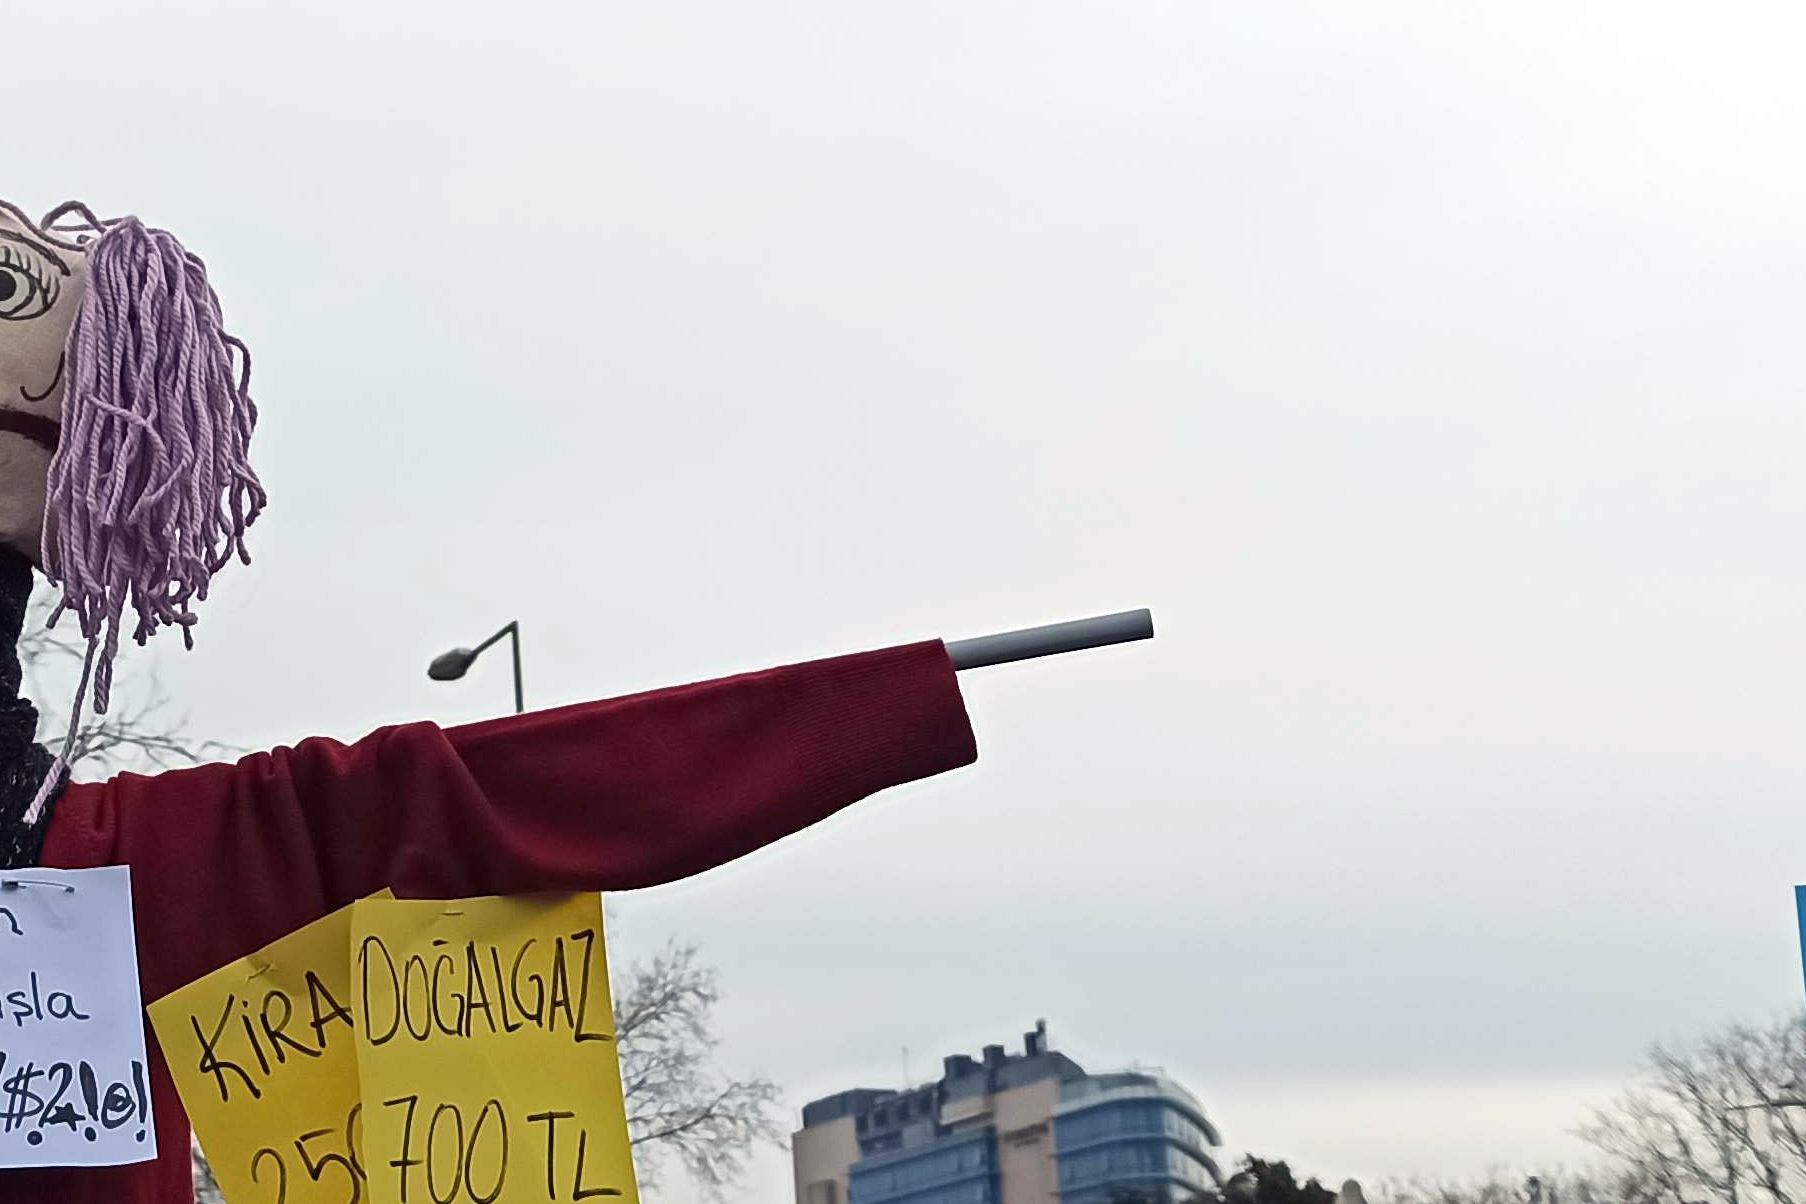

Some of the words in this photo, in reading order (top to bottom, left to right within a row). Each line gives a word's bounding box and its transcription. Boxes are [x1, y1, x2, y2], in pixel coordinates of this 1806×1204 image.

[191, 970, 354, 1102] KİRA
[358, 928, 613, 1046] DOĞALGAZ
[526, 1110, 623, 1203] TL
